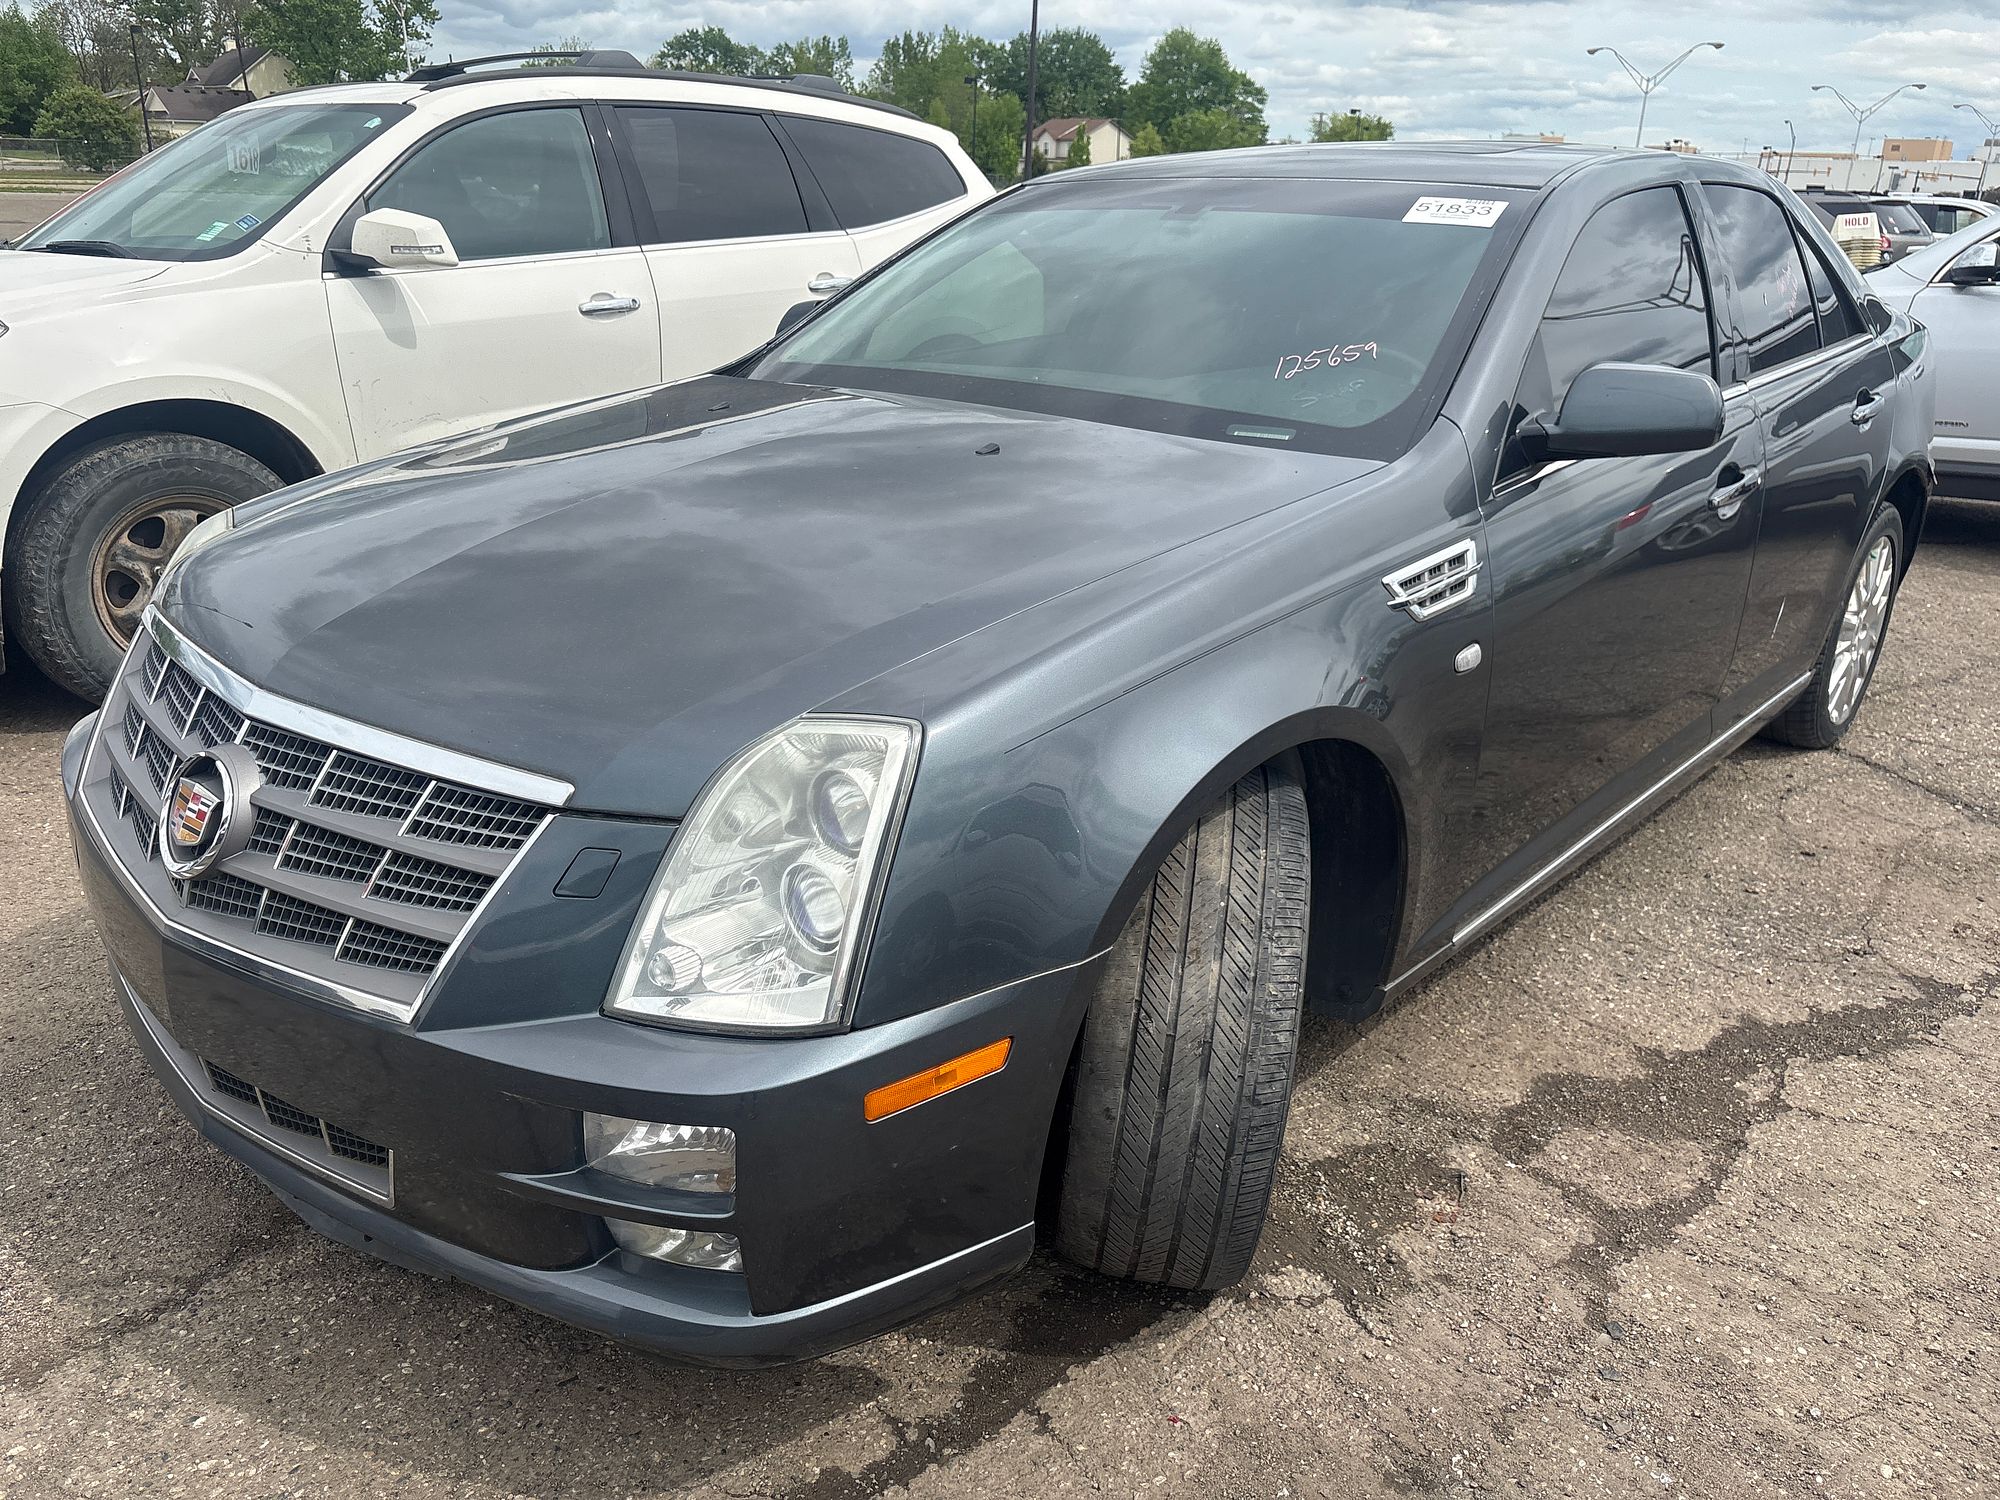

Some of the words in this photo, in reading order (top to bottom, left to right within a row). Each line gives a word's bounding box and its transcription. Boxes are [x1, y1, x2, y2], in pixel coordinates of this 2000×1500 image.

[1415, 202, 1493, 216] 51833
[1844, 216, 1869, 227] HOLD
[1274, 340, 1378, 380] 125659
